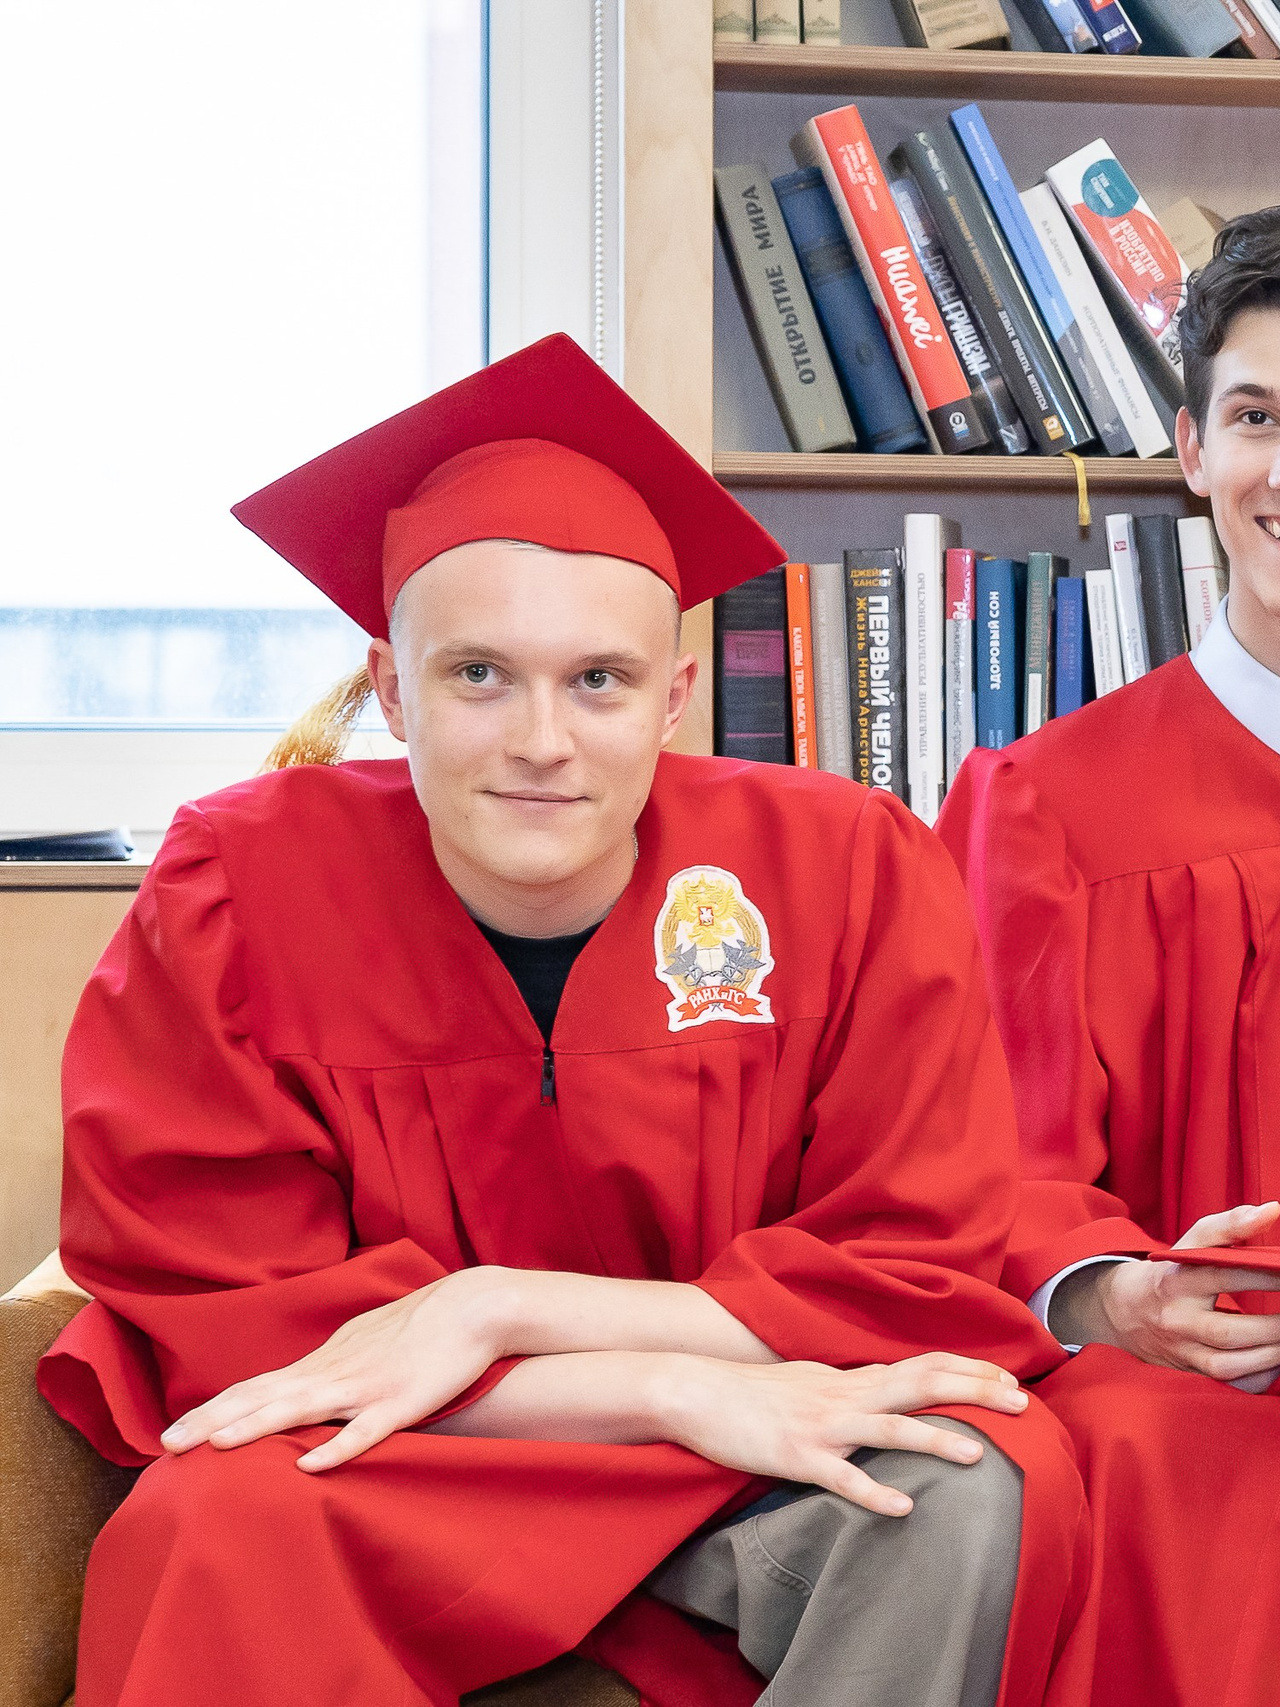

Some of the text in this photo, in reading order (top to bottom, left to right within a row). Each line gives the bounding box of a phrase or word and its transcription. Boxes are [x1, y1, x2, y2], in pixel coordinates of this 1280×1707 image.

[738, 184, 820, 386] ОТКРЫТИЕ МИРА
[1115, 236, 1150, 277] РОССИИ
[1119, 219, 1166, 283] ИЗОБРЕТЕНО
[878, 242, 943, 352] Huawei
[938, 299, 992, 377] ГРИШЭМ
[1081, 303, 1141, 420] КОРПОРАТИВНЫЕ ФИНАНСЫ
[792, 627, 803, 665] КАКОВЫ
[794, 669, 804, 694] ТВОИ
[868, 595, 894, 706] ПЕРВЫЙ
[916, 572, 928, 757] УПРАВЛЕНИЕ РЕЗУЛЬТАТИВНОСТЬЮ
[988, 591, 1001, 689] ЗДОРОВЫЙ СОН
[856, 597, 870, 788] Жизнь Нила Армстрон
[797, 738, 808, 768] ТАКОВ
[688, 987, 746, 1009] РАНХиГС
